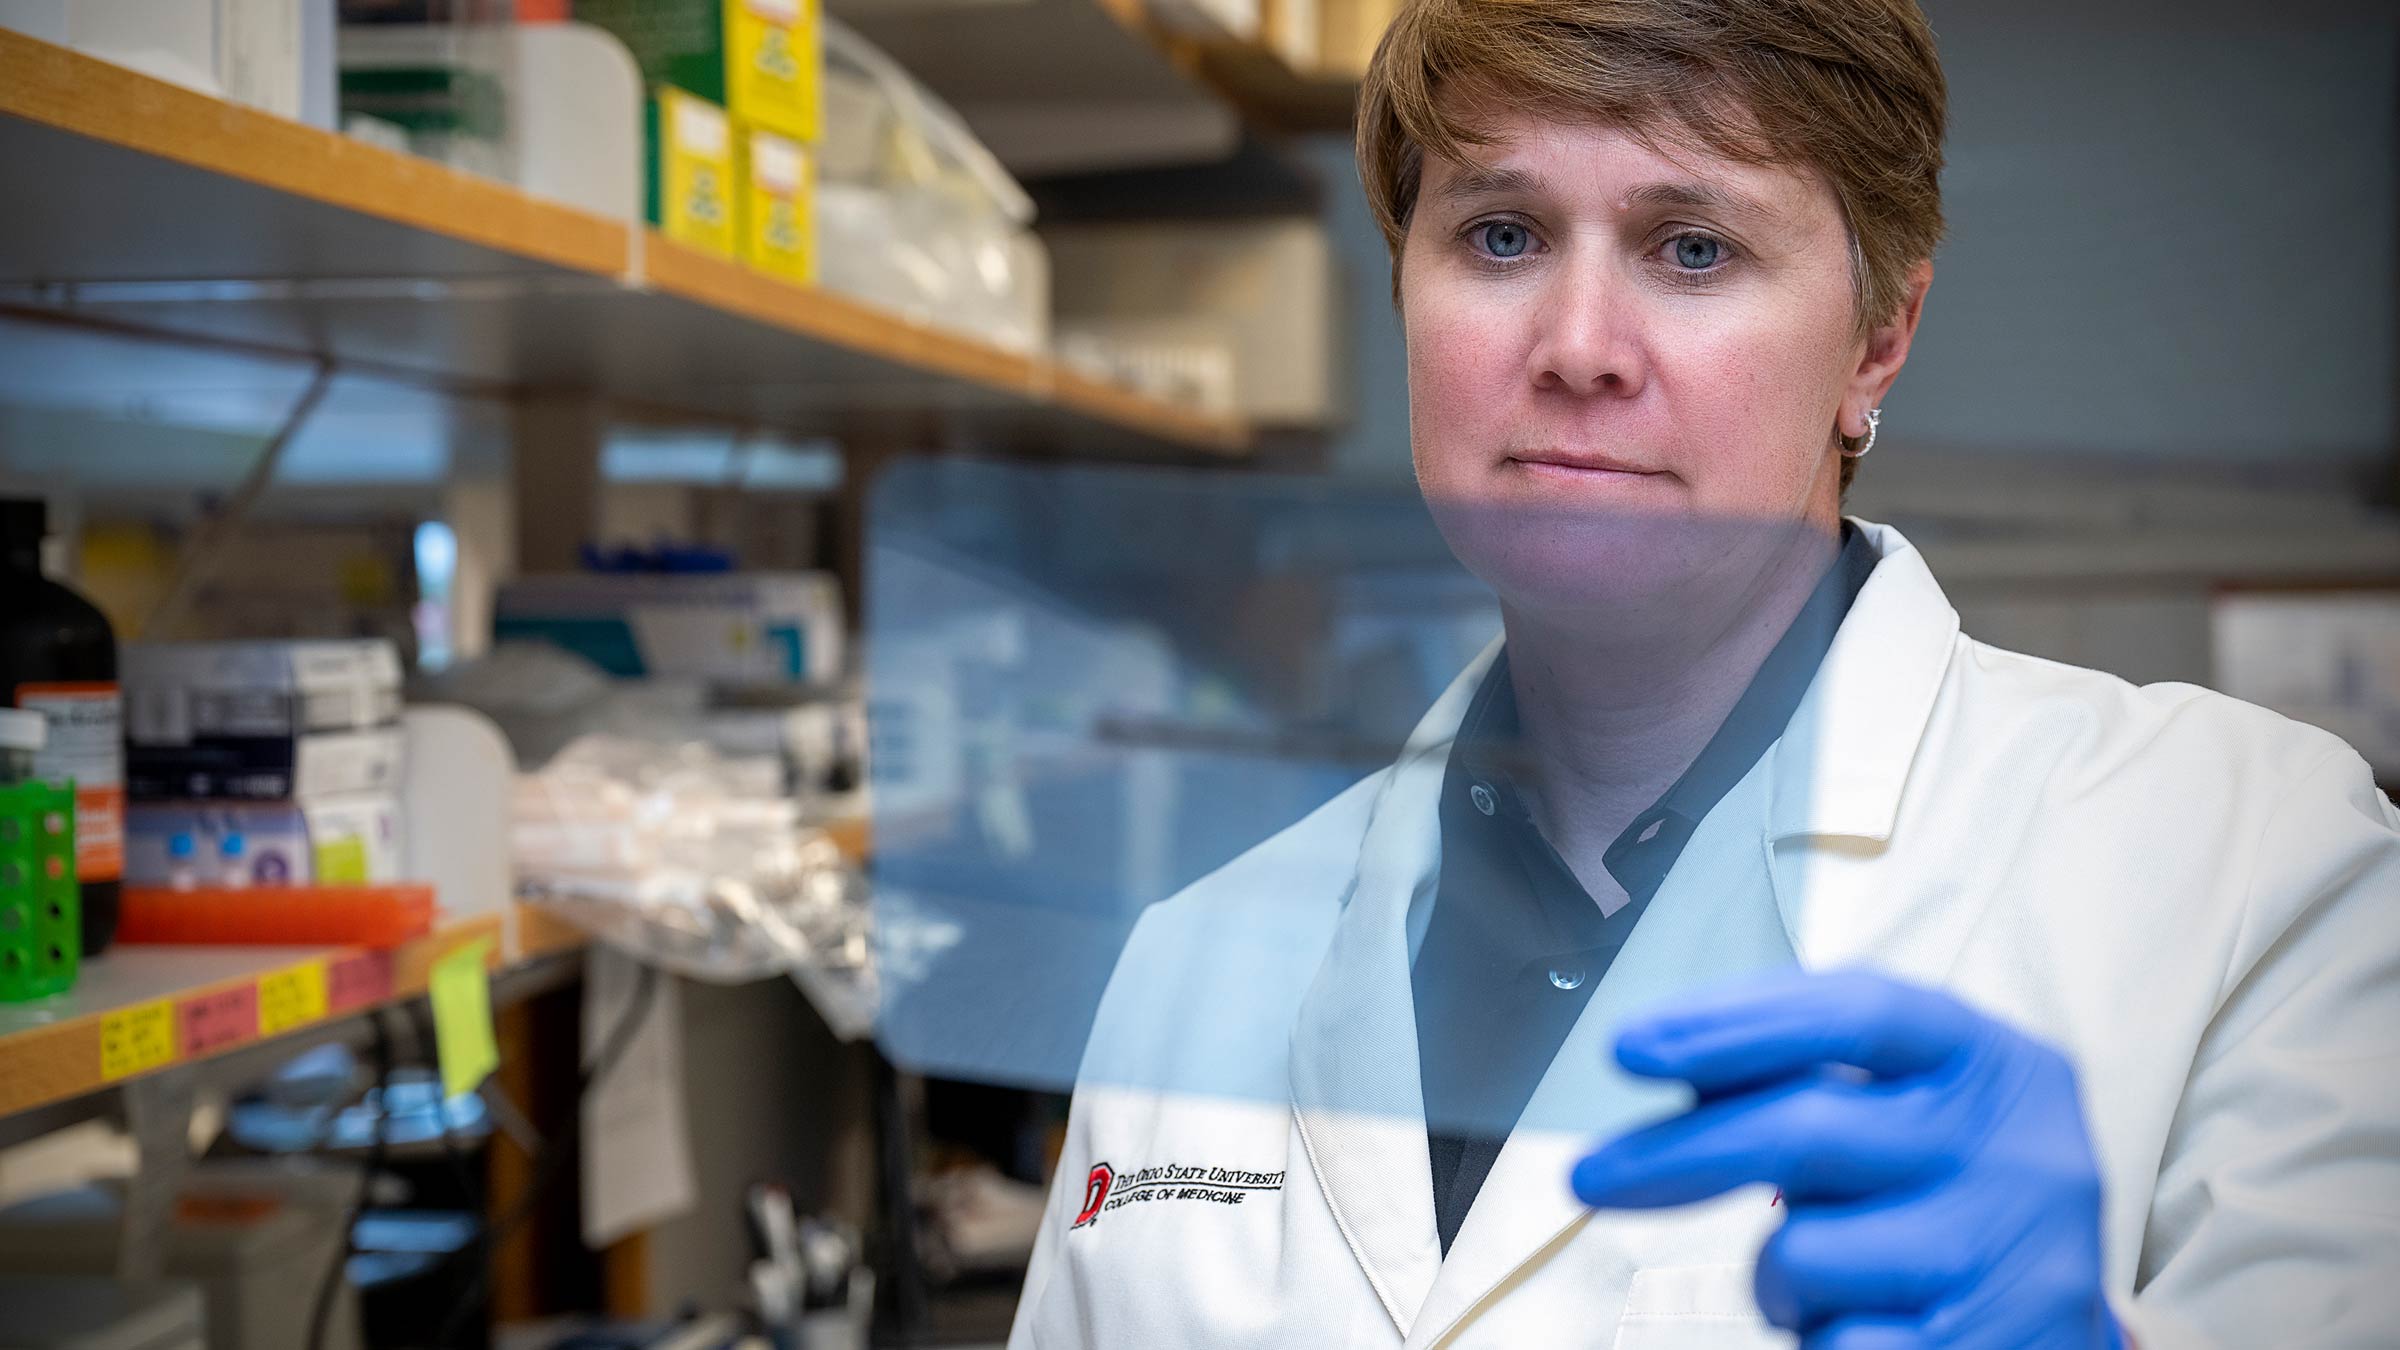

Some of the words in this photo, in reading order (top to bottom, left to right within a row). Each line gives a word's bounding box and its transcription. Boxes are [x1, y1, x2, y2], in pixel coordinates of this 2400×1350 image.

[1136, 1167, 1163, 1183] OHIO
[1164, 1163, 1207, 1180] STATE
[1104, 1189, 1155, 1211] COLLEGE
[1156, 1188, 1175, 1201] OF
[1176, 1187, 1246, 1205] MEDICINE
